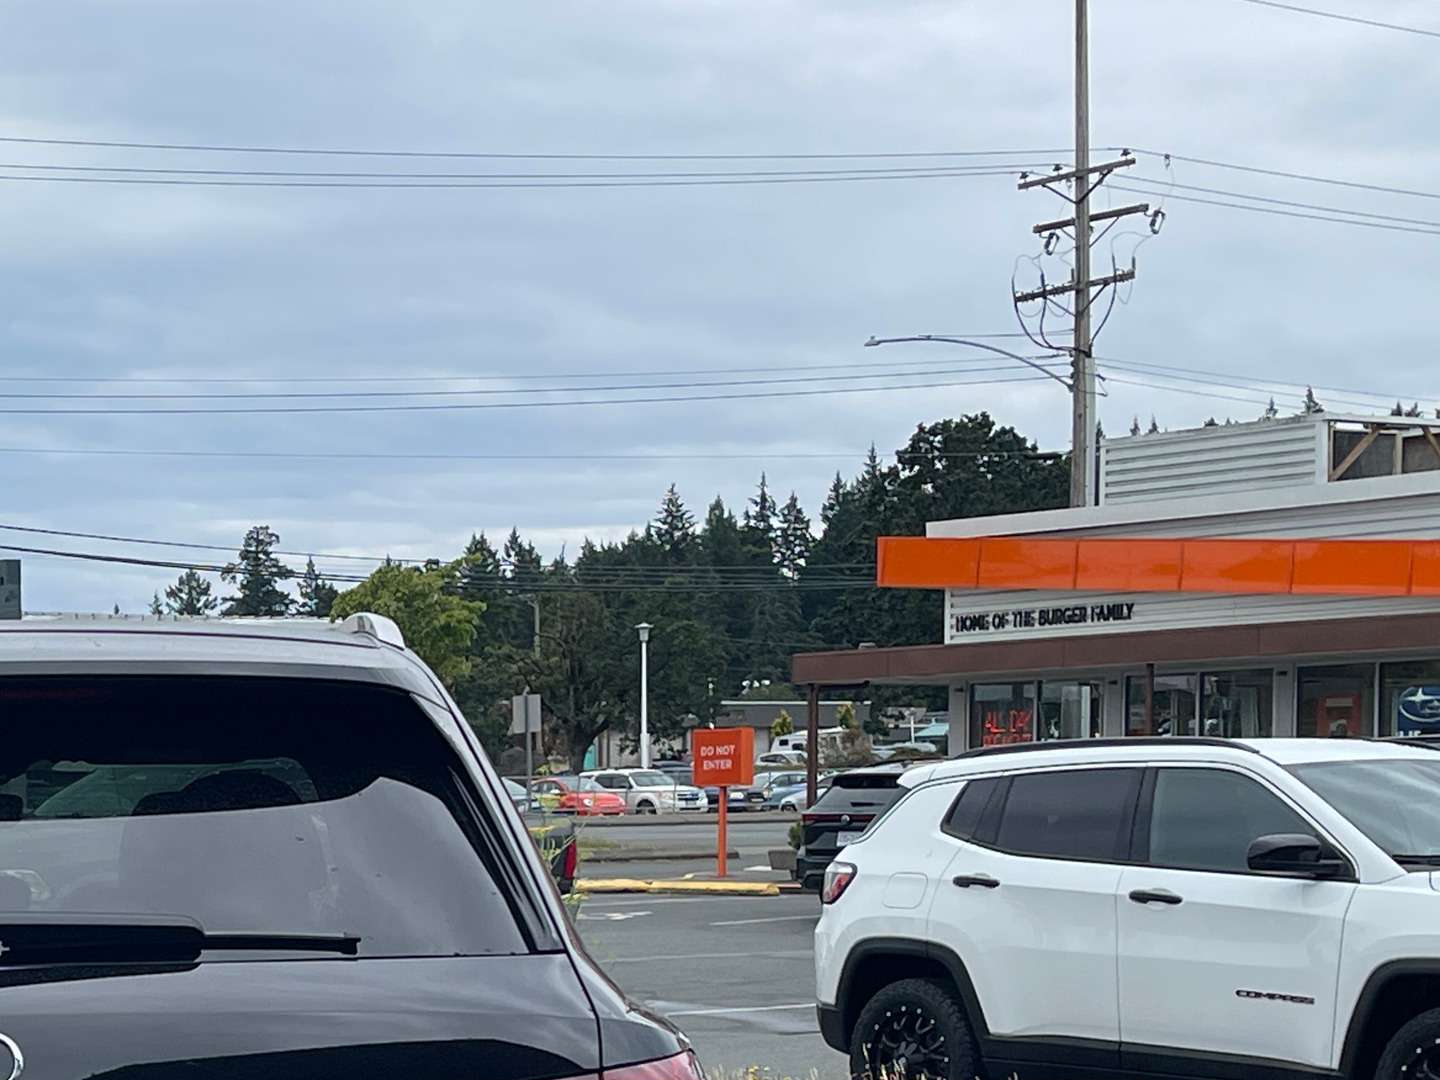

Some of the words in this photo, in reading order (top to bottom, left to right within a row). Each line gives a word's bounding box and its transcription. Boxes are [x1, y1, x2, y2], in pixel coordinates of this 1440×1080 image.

[956, 614, 990, 632] HOME
[992, 612, 1009, 630] OF
[1012, 610, 1036, 628] THE
[1038, 606, 1087, 626] BURGER
[1090, 603, 1135, 622] FAMILY
[700, 746, 714, 756] DO
[715, 744, 736, 756] NOT
[703, 760, 732, 770] ENTER
[1235, 989, 1315, 1005] COMPASS
